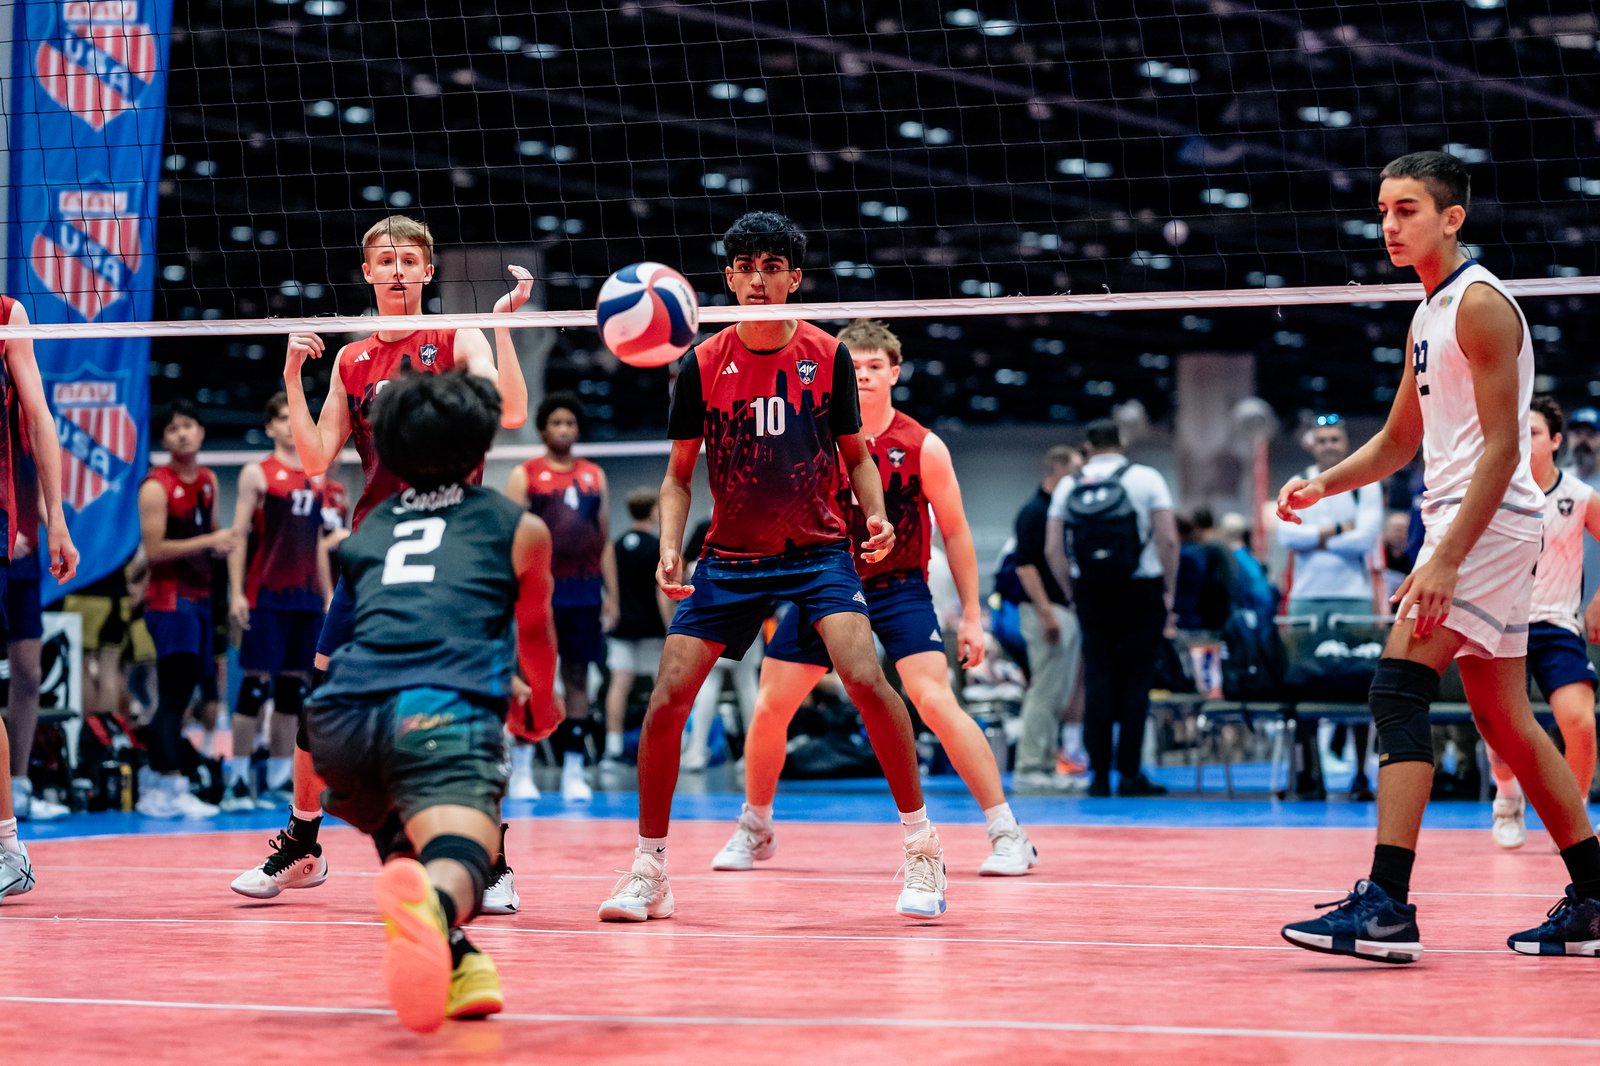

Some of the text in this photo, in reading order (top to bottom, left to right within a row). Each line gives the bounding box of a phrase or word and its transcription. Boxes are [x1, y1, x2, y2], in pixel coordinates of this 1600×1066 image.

[65, 33, 128, 97] USA
[61, 224, 120, 287] USA
[56, 416, 110, 479] USA
[750, 396, 786, 437] 10
[292, 489, 313, 516] 27
[381, 516, 447, 585] 2
